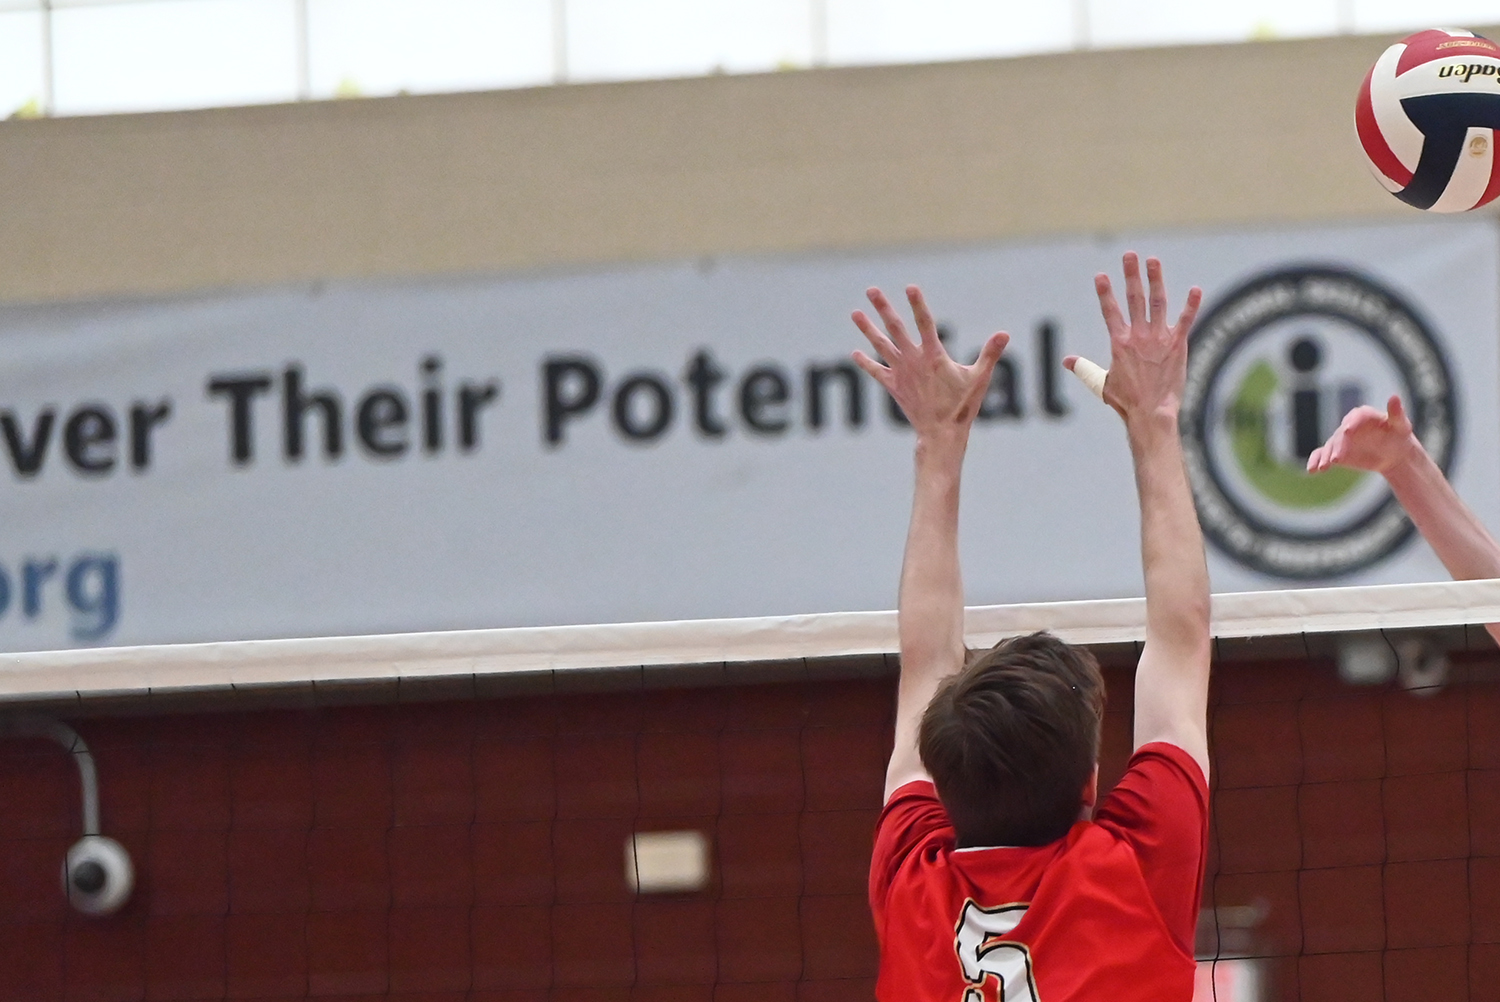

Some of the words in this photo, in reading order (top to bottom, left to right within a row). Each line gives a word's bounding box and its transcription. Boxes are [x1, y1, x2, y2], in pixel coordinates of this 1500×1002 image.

[0, 402, 172, 480] ver
[206, 355, 499, 467] Their
[540, 315, 1070, 447] Potenal
[0, 551, 122, 643] rg
